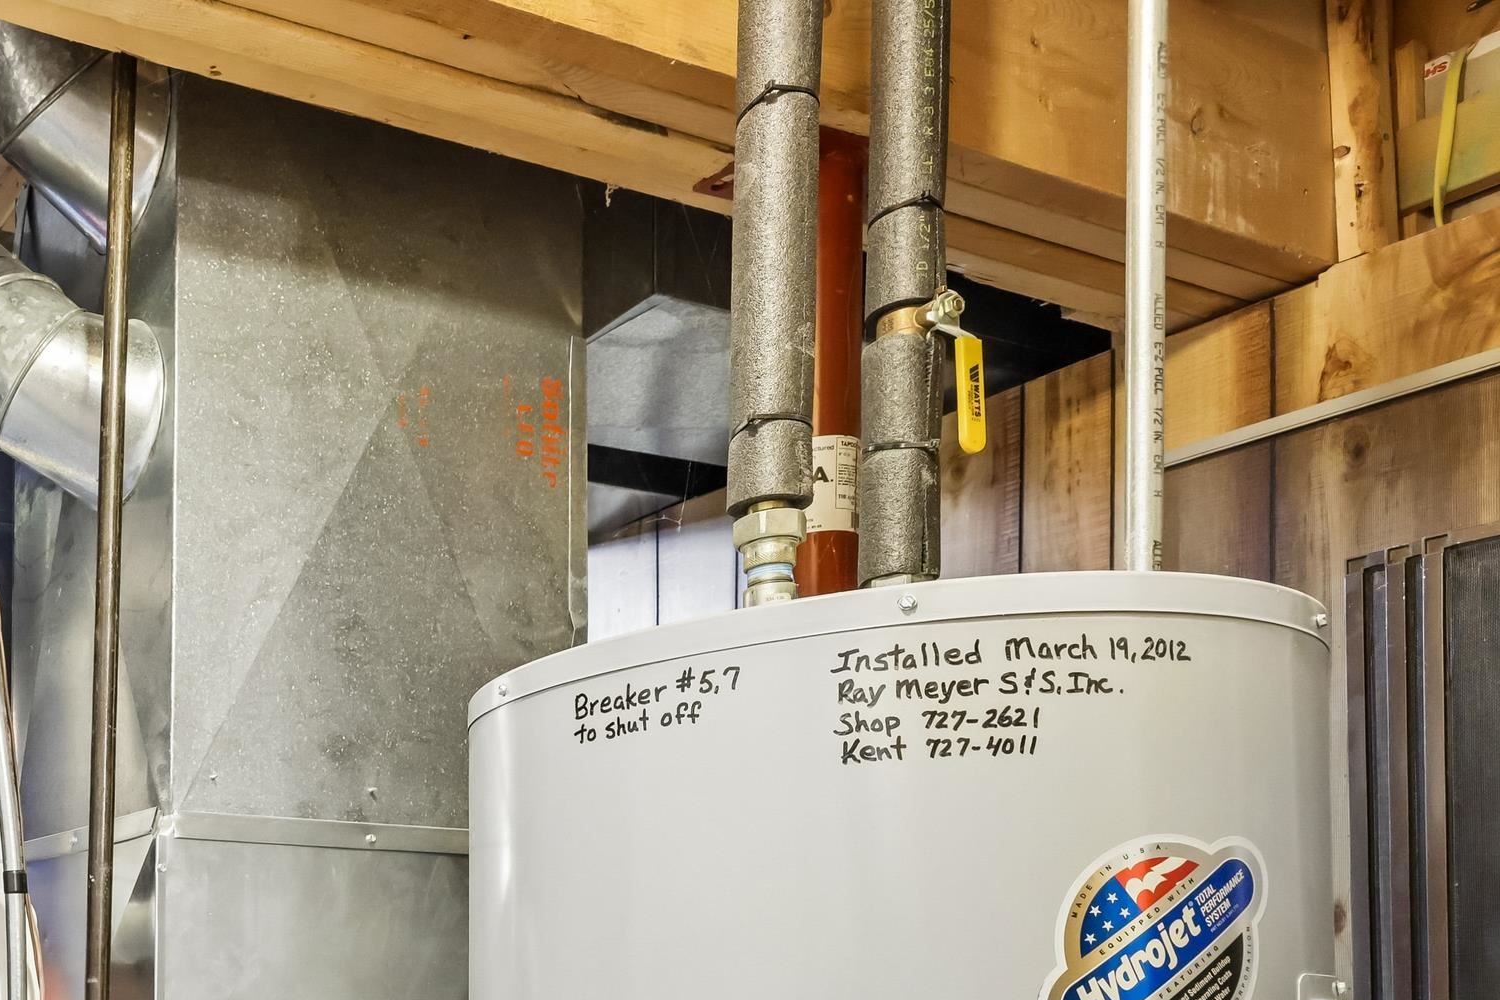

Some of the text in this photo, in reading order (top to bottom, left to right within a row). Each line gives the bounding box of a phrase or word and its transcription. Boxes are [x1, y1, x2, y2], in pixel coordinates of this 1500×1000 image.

[1155, 118, 1166, 146] PULL
[1154, 293, 1164, 331] ALLIED
[1154, 341, 1164, 362] E-Z
[1153, 366, 1164, 395] PULL
[974, 384, 982, 418] WATTS
[1153, 407, 1163, 425] 1/2
[1152, 539, 1162, 571] ALLIE
[830, 639, 982, 674] Installed
[1005, 633, 1098, 661] March
[574, 683, 668, 721] Breaker
[838, 679, 886, 707] Ray
[896, 675, 990, 705] Meyer
[574, 700, 702, 744] to shut off
[833, 705, 1040, 738] Shop 727-2621
[841, 735, 1037, 765] Kent 727-4011
[1071, 884, 1093, 919] MADE
[1099, 864, 1112, 877] IN
[1194, 883, 1217, 906] TOTAL
[1200, 868, 1245, 917] PERFORMANCE
[1099, 877, 1195, 956] EQUIPPED WITH
[1204, 897, 1232, 927] SYSTEM
[1158, 945, 1219, 999] FEATURING
[1187, 971, 1214, 997] Sediment
[1210, 955, 1231, 976] Buildup
[1217, 970, 1233, 985] Costs
